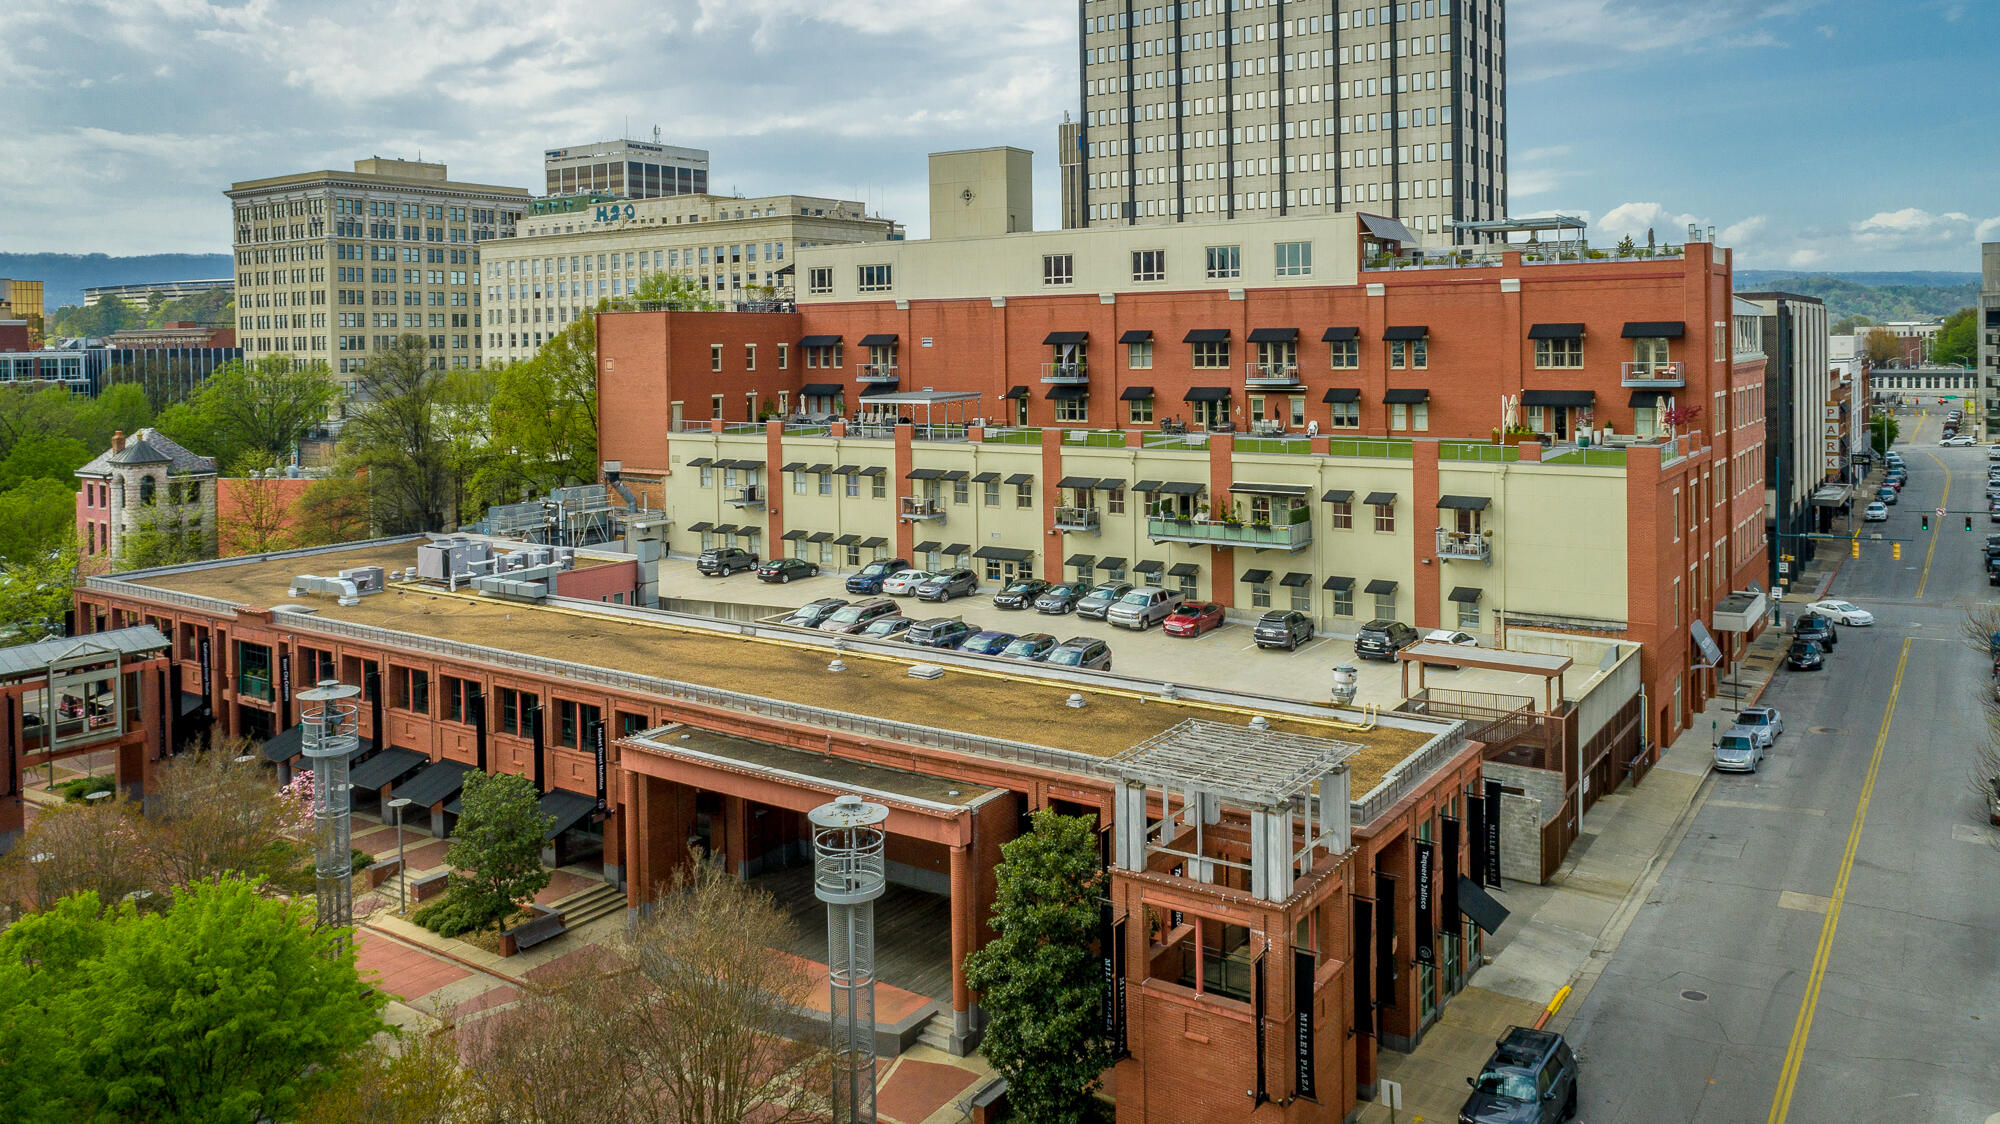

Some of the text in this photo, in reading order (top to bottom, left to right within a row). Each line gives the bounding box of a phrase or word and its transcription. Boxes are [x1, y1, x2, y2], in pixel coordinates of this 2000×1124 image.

[596, 204, 635, 222] H2O
[1827, 408, 1836, 467] PARK
[1420, 850, 1429, 910] Taqueria Jalisco
[1300, 1012, 1309, 1092] MILLER PLAZA
